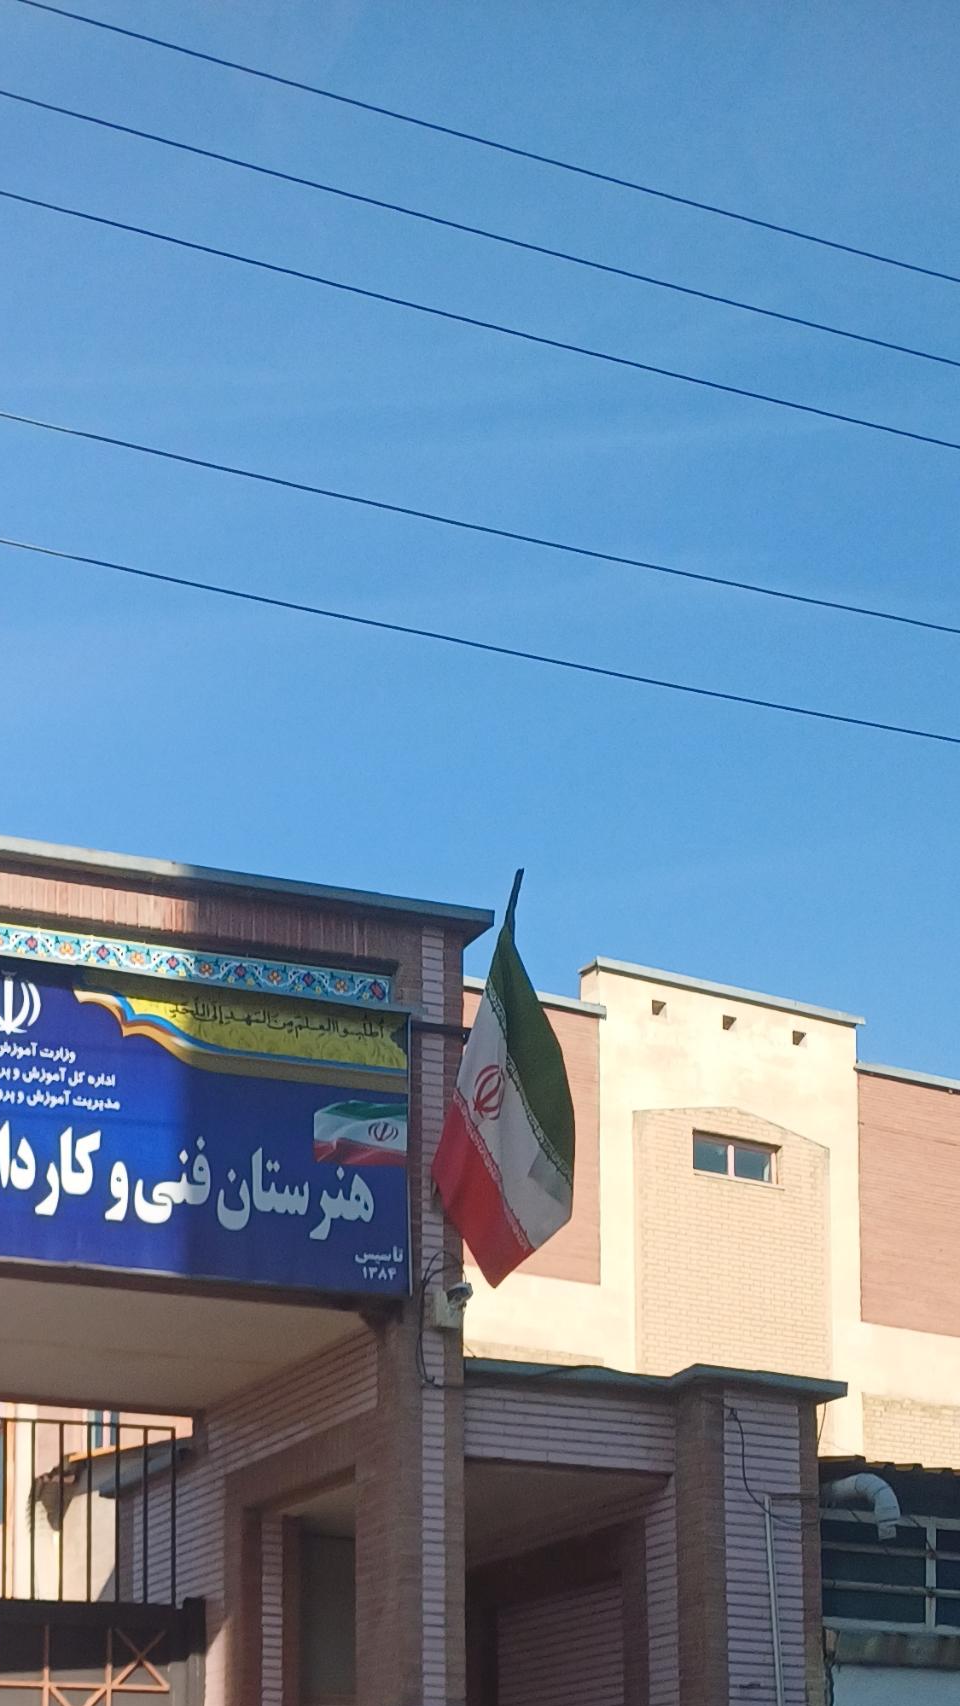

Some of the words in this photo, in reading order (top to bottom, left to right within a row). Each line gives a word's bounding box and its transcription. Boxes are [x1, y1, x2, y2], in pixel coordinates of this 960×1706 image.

[39, 1046, 77, 1064] وزارت
[12, 1067, 20, 1081] و
[21, 1066, 67, 1086] آموزش
[68, 1070, 86, 1087] کل
[87, 1072, 116, 1088] اداره
[16, 1090, 25, 1105] و
[26, 1089, 72, 1109] آموزش
[72, 1095, 121, 1112] مدیریت
[133, 1136, 212, 1225] فنی
[104, 1160, 130, 1222] و
[216, 1147, 376, 1241] هنرستان
